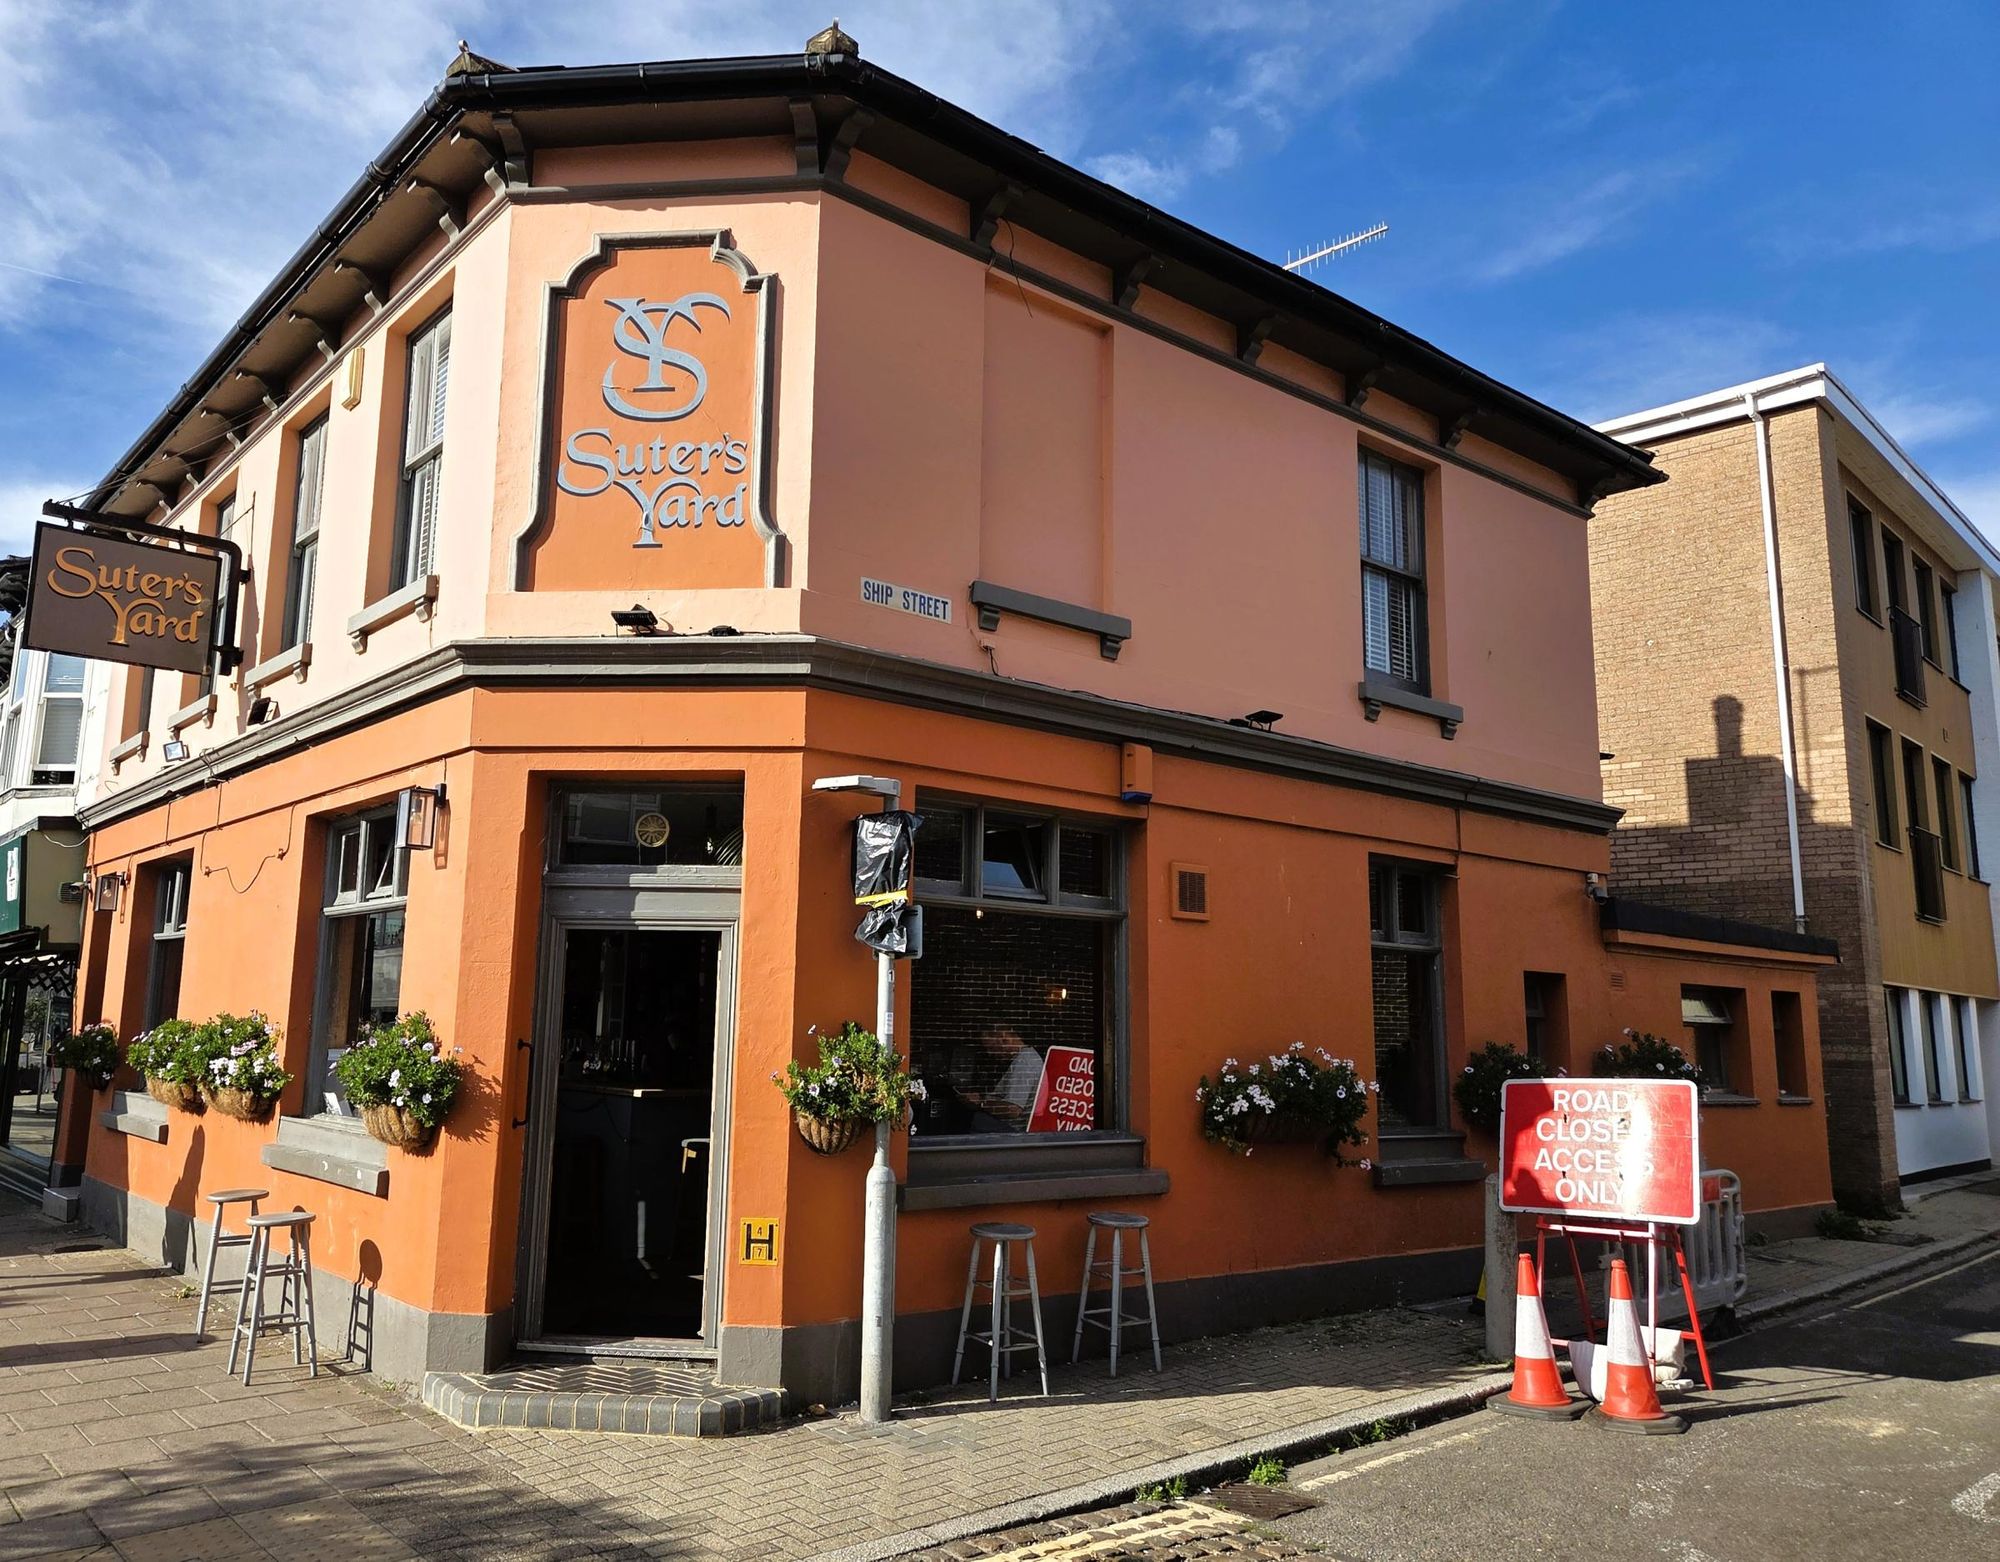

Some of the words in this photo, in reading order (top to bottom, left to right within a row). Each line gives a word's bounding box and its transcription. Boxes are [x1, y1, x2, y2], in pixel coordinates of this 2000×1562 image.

[557, 427, 748, 497] Suter's
[613, 477, 747, 549] Yard
[47, 547, 207, 606] Suter's
[863, 580, 893, 605] SHIP
[902, 590, 949, 620] STREET
[95, 590, 206, 648] Yard
[1553, 1089, 1632, 1113] ROAD
[746, 1224, 774, 1259] H
[757, 1227, 762, 1236] 4
